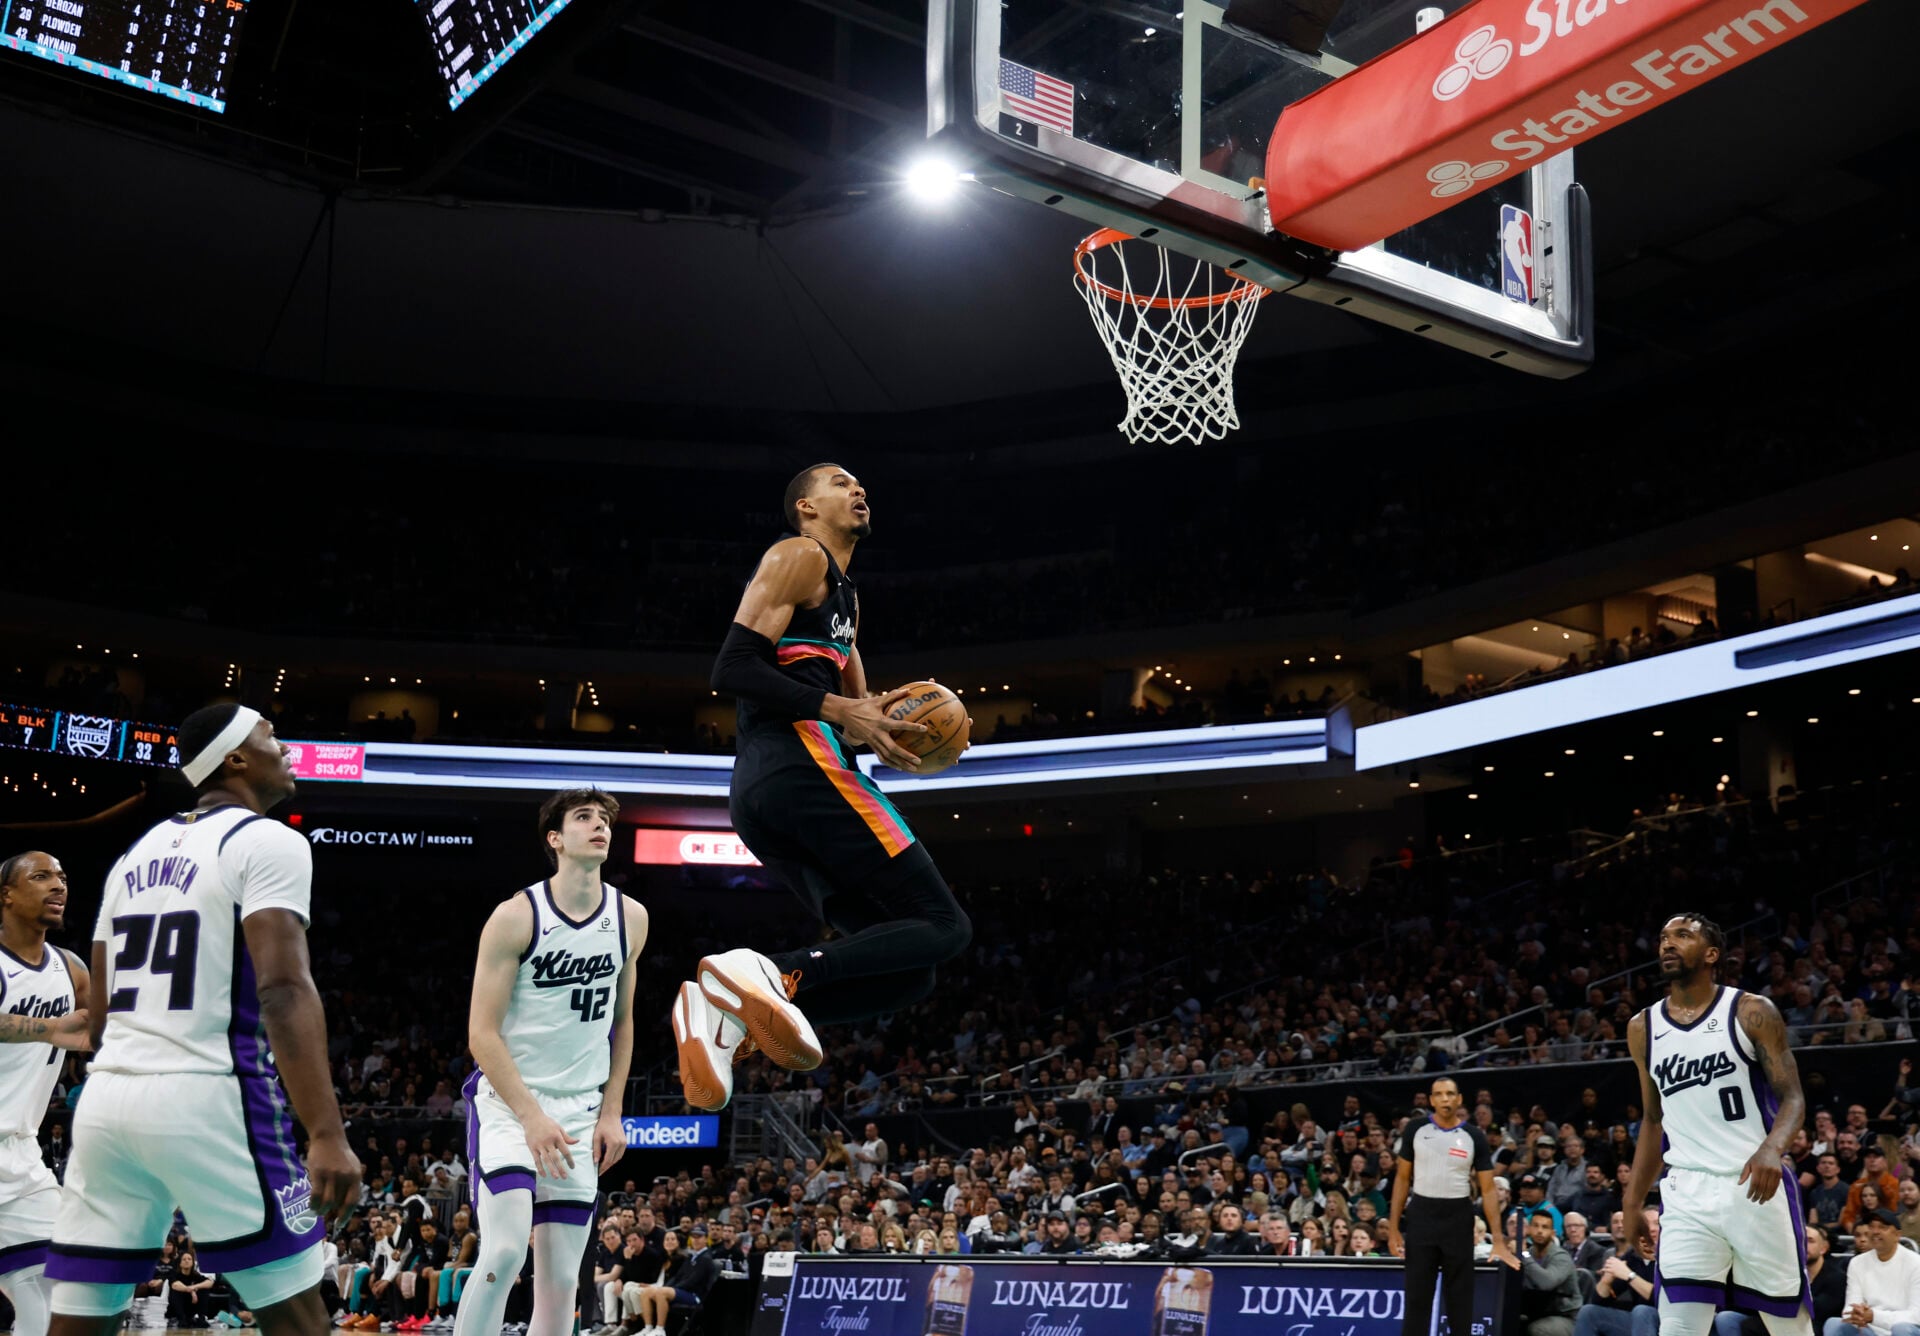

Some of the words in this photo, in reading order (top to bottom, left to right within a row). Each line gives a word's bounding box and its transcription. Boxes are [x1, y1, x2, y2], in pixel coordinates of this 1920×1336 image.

[226, 0, 243, 11] PF
[134, 4, 141, 16] 4
[223, 33, 231, 46] 2
[1520, 0, 1628, 56] Sta
[15, 27, 28, 40] 42
[37, 33, 77, 55] RAYNAUD
[41, 14, 82, 37] PLOWDEN
[156, 51, 164, 64] 2
[219, 51, 227, 64] 2
[1015, 123, 1022, 136] 2
[1507, 279, 1523, 298] NBA
[18, 715, 46, 728] BLK
[24, 727, 33, 744] 7
[70, 731, 108, 743] KINGS
[134, 731, 160, 743] REB
[136, 742, 152, 760] 32
[315, 763, 358, 776] $13,470
[320, 828, 417, 845] CHOCTAW
[427, 835, 473, 845] RESORTS
[125, 856, 199, 899] PLOWDEN
[108, 910, 201, 1013] 29
[531, 949, 616, 987] Kings
[570, 986, 611, 1022] 42
[1654, 1051, 1737, 1097] Kings
[1718, 1086, 1746, 1121] 0
[624, 1120, 700, 1145] indeed
[798, 1277, 907, 1302] LUNAZUL
[991, 1280, 1129, 1309] LUNAZUL
[821, 1305, 870, 1336] Tequila
